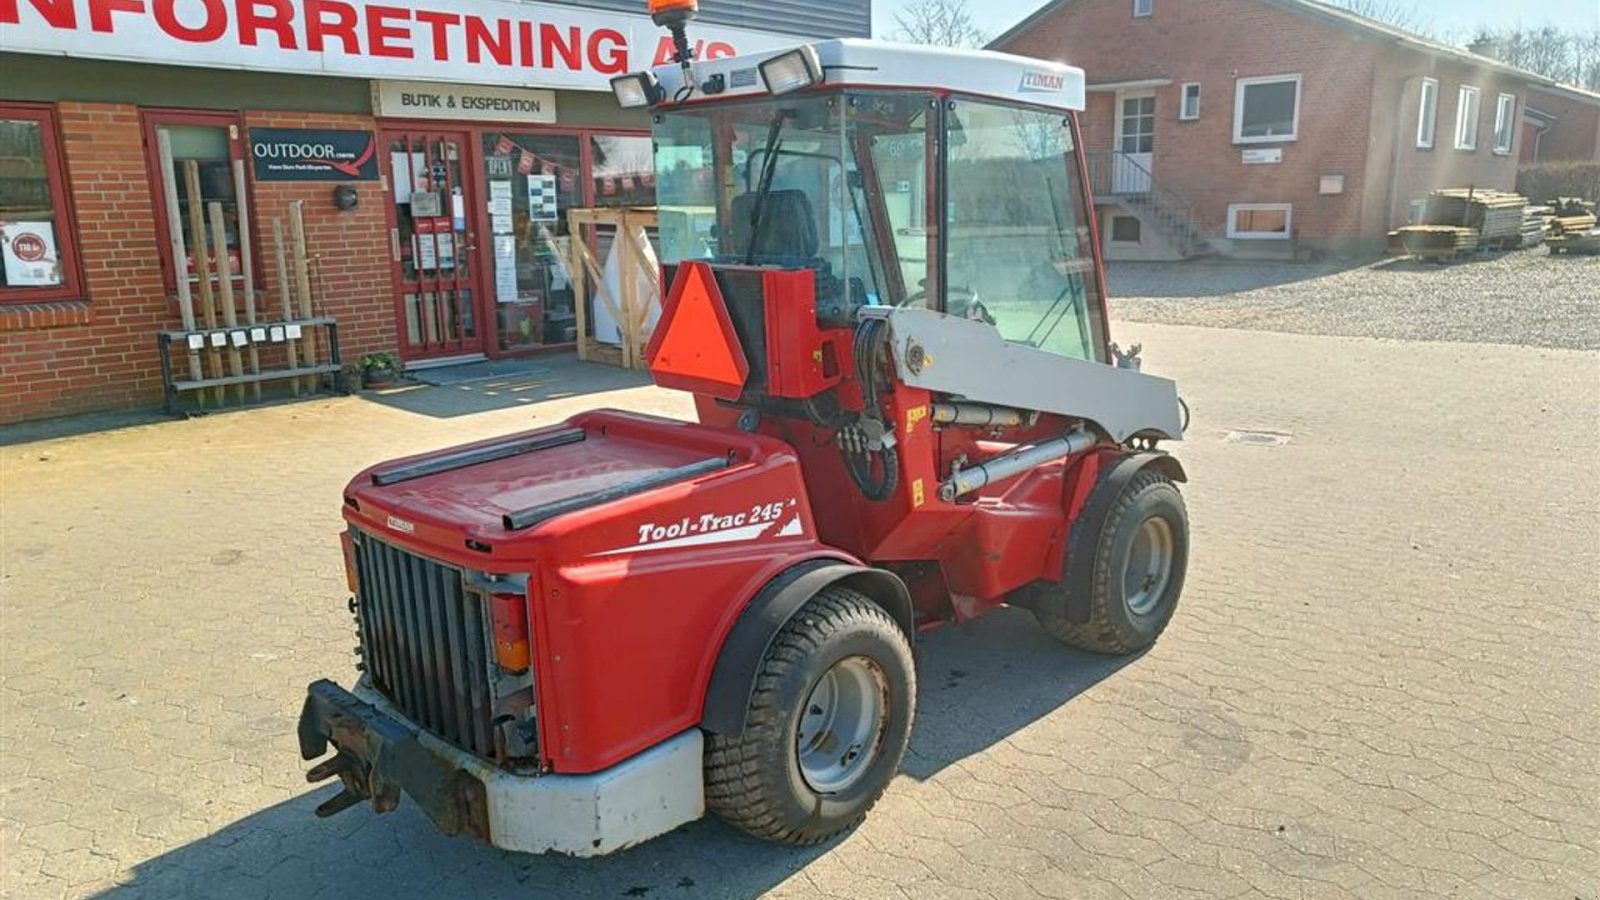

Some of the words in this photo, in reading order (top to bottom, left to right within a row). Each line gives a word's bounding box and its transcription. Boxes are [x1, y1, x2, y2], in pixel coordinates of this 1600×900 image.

[653, 36, 737, 67] A/S
[1024, 72, 1064, 90] TIMAN
[401, 93, 442, 109] BUTIK
[446, 95, 456, 109] &
[461, 96, 541, 113] EKSPEDITION
[254, 143, 336, 159] OUTDOOR
[638, 511, 746, 543] Tool-Trac
[749, 502, 784, 525] 245
